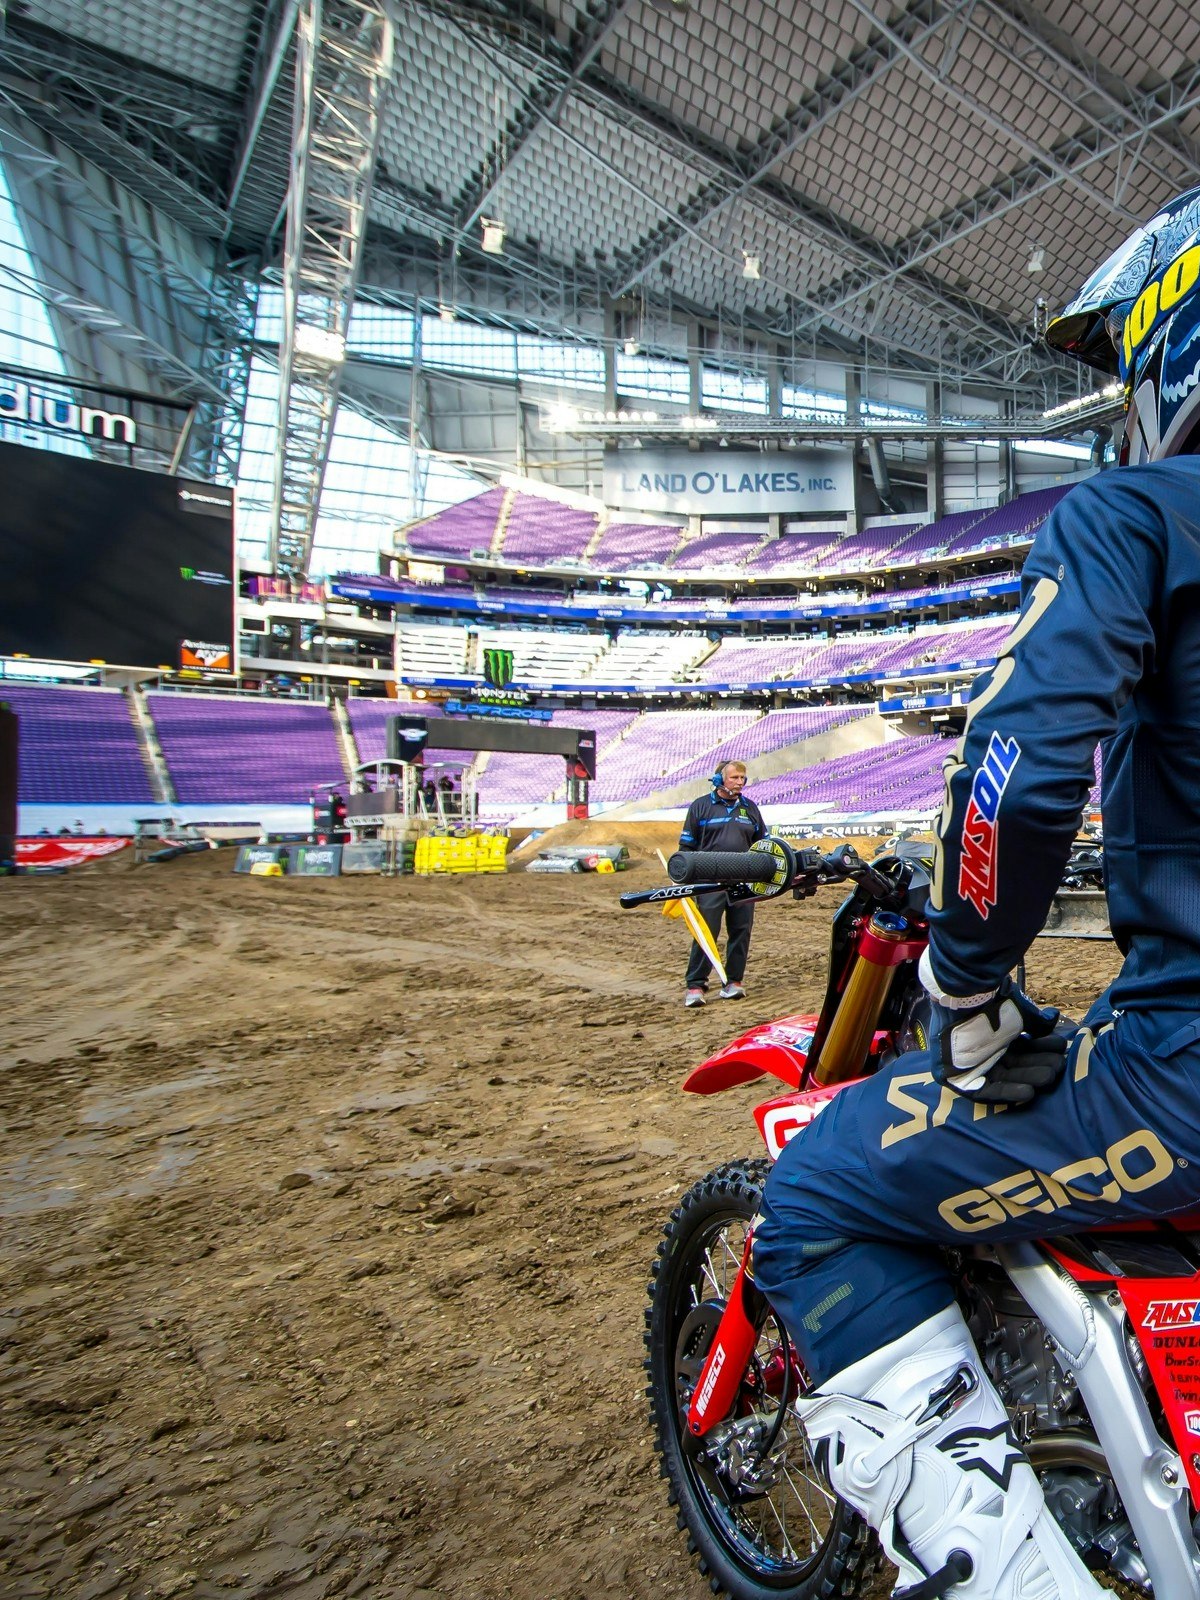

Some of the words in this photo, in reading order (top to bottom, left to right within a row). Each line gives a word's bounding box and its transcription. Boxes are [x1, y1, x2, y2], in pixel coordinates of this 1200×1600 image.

[0, 381, 136, 443] dium
[621, 473, 686, 493] LAND
[808, 478, 837, 491] INC.
[470, 687, 530, 701] MONSTER
[958, 730, 1022, 921] AMSOIL
[649, 884, 695, 900] ARC
[938, 1129, 1174, 1232] GEICO
[1174, 1389, 1198, 1400] Twin
